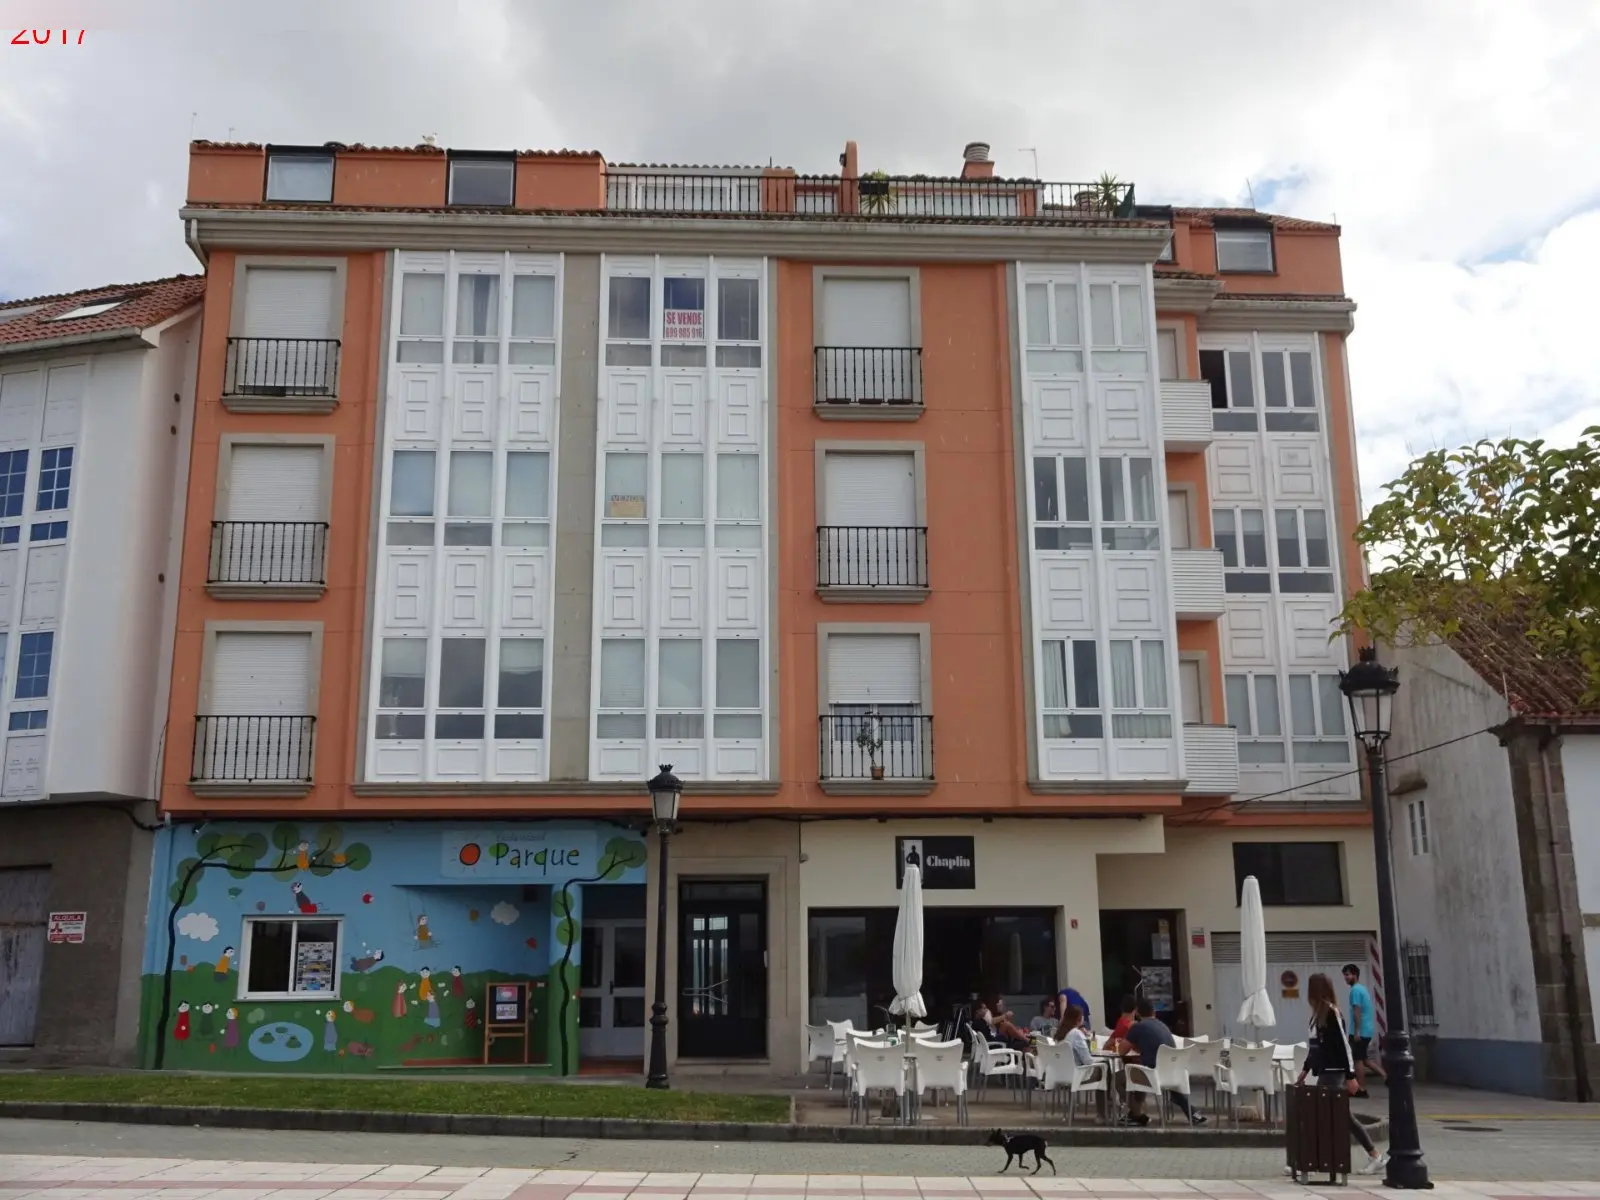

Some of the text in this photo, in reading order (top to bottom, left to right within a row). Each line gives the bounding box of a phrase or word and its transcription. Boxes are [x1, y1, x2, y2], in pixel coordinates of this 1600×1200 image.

[666, 311, 703, 326] SE VENDE
[495, 842, 580, 876] Parque
[925, 855, 971, 870] Chaplin
